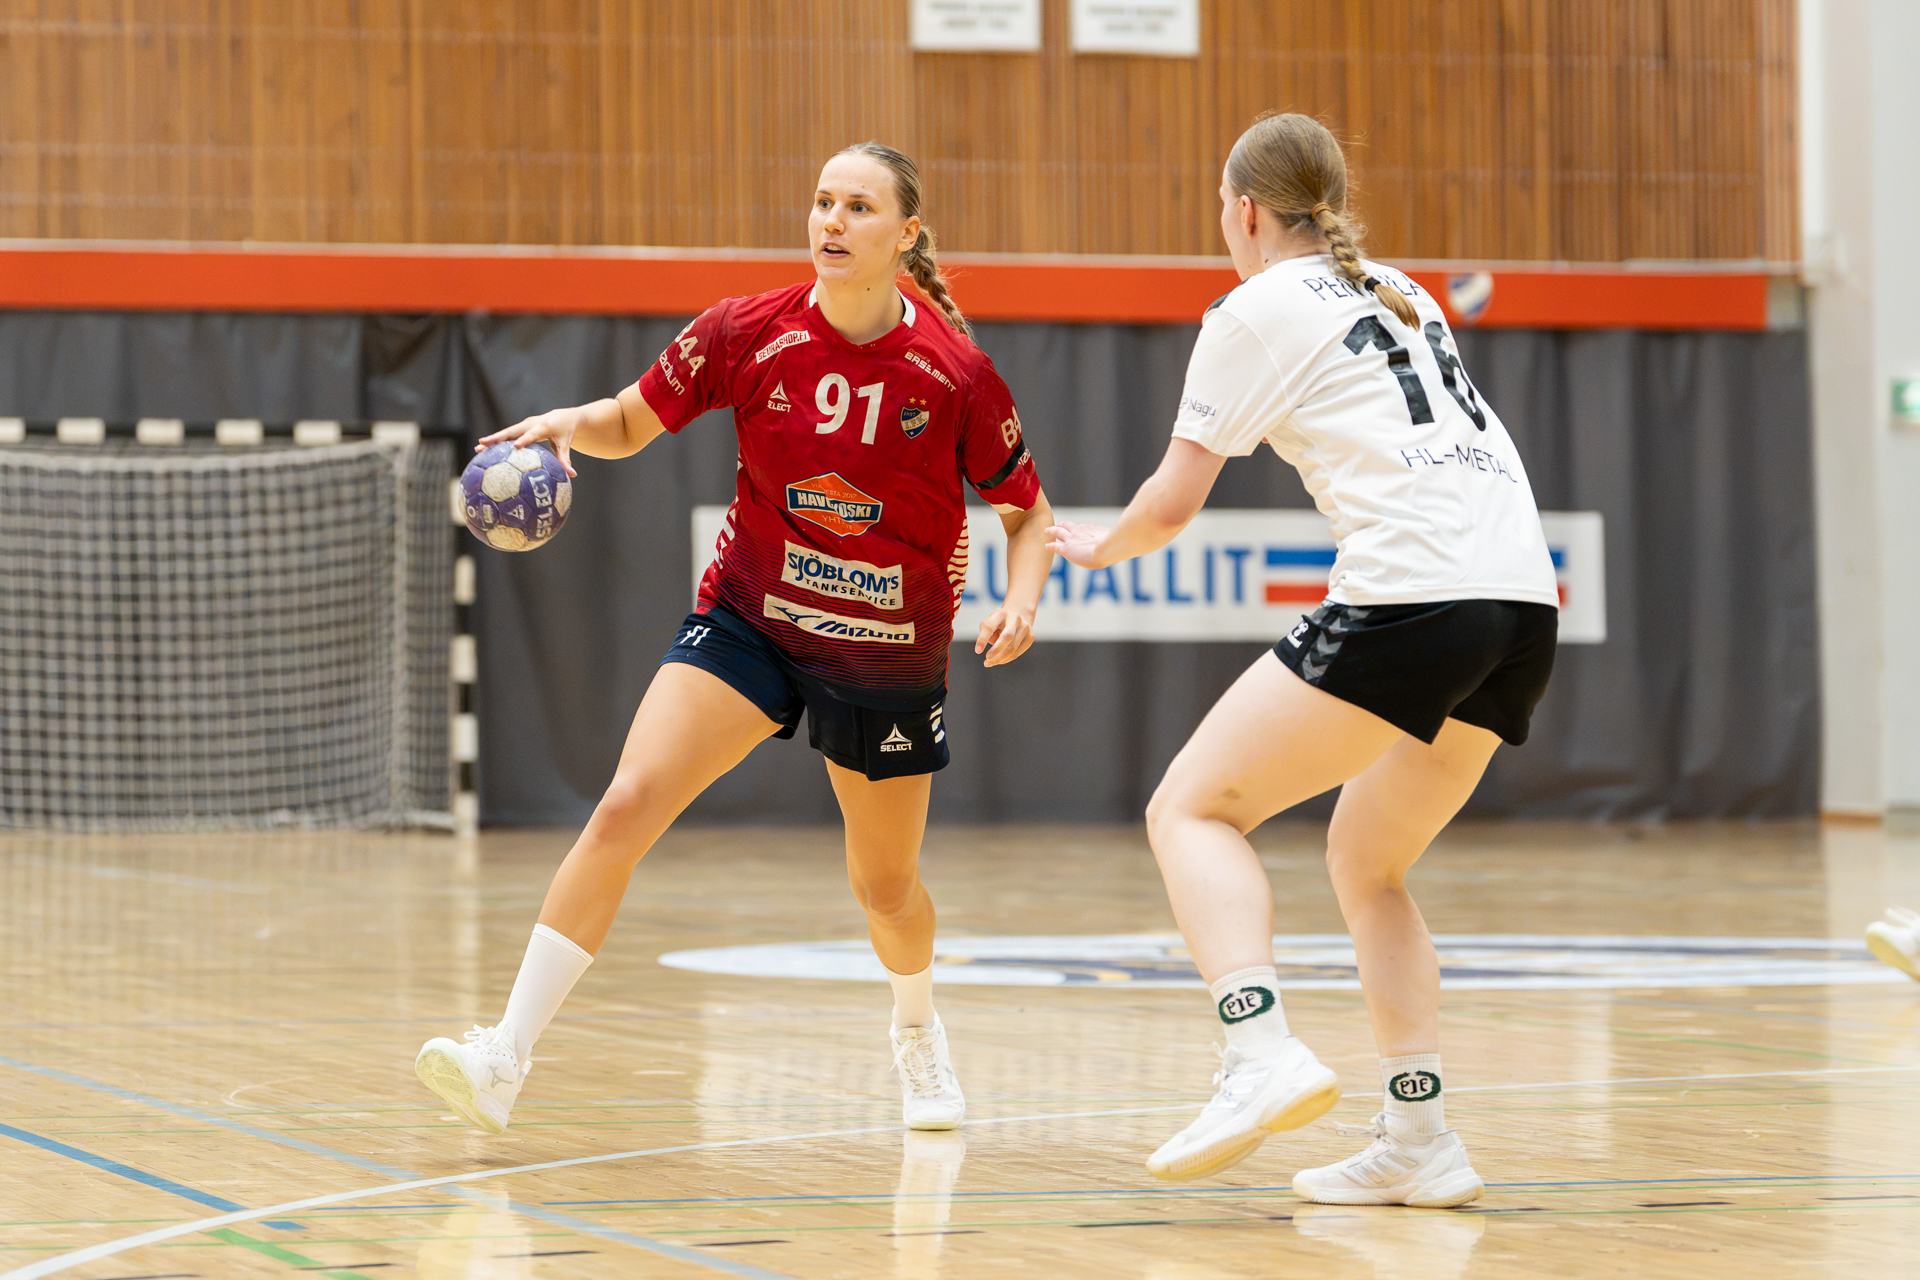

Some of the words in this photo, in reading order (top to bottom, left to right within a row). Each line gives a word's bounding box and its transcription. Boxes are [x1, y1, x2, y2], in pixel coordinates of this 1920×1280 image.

[758, 332, 807, 360] SEURASHOP.FI
[659, 349, 685, 396] adium
[1343, 315, 1486, 432] 16
[815, 373, 884, 445] 91
[1188, 398, 1216, 417] Nagu
[787, 552, 899, 594] SJÖBLOM'S
[805, 577, 896, 606] TANKSERVICE
[880, 743, 912, 752] SELECT
